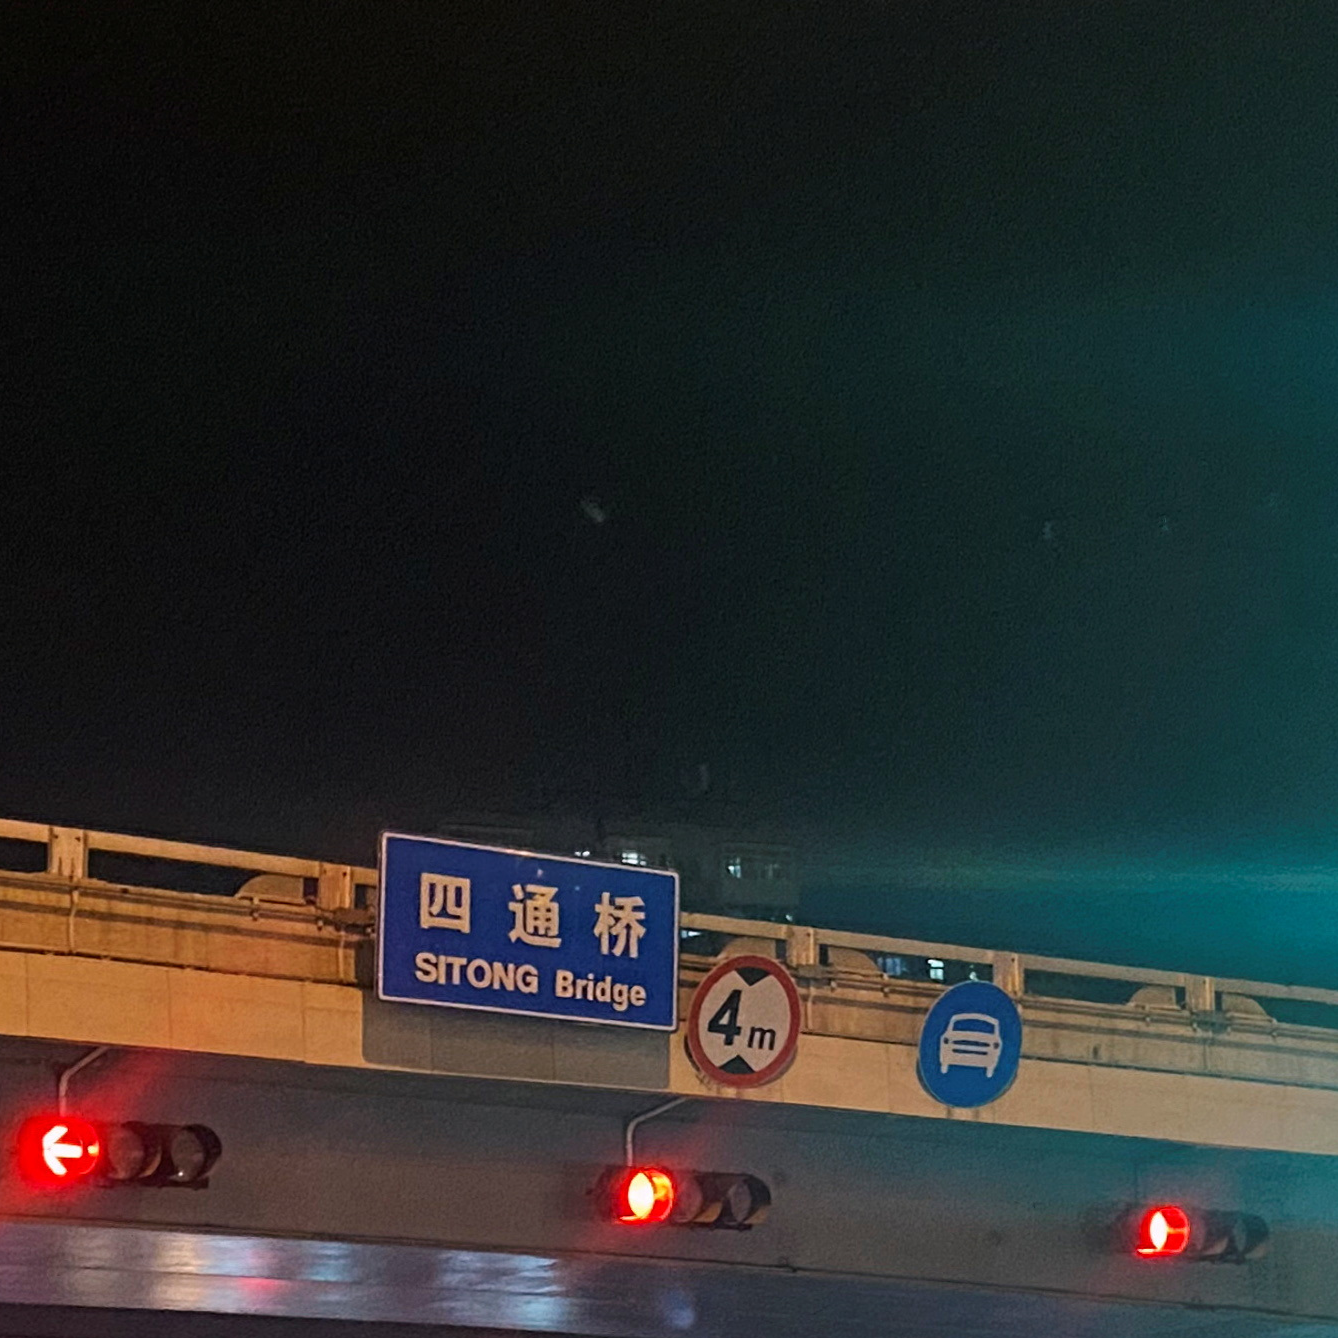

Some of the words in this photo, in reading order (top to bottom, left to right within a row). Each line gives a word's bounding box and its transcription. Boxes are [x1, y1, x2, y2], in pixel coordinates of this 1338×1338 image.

[420, 872, 647, 959] 四通桥
[415, 952, 538, 994] SITONG
[555, 969, 647, 1012] Bridge
